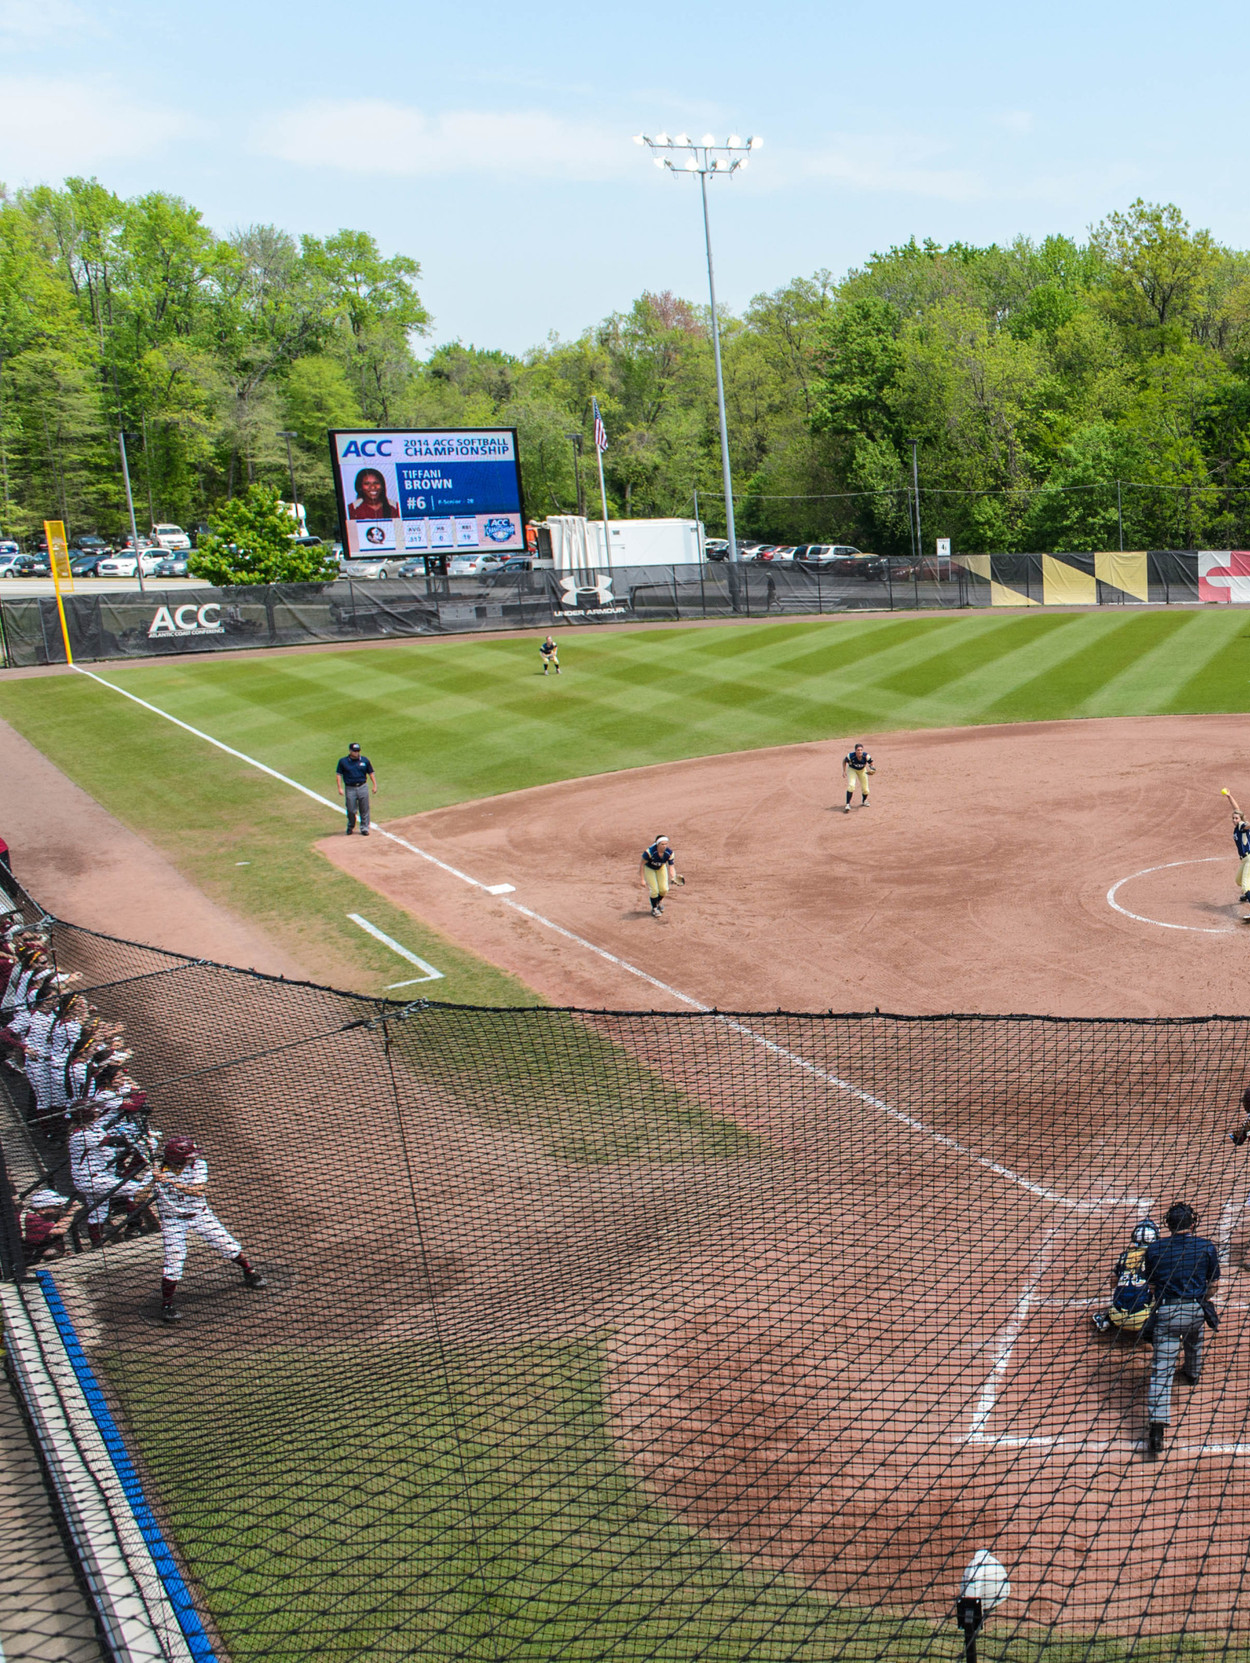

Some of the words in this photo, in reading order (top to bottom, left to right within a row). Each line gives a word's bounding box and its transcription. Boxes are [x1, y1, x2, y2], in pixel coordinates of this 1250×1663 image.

[342, 440, 392, 457] ACC
[405, 446, 510, 456] CHAMPIONSHIP
[402, 470, 441, 479] TIFFANI
[405, 479, 452, 490] BROWN
[407, 496, 426, 510] #6
[586, 607, 625, 615] ARMOUR
[148, 603, 221, 632] ACC
